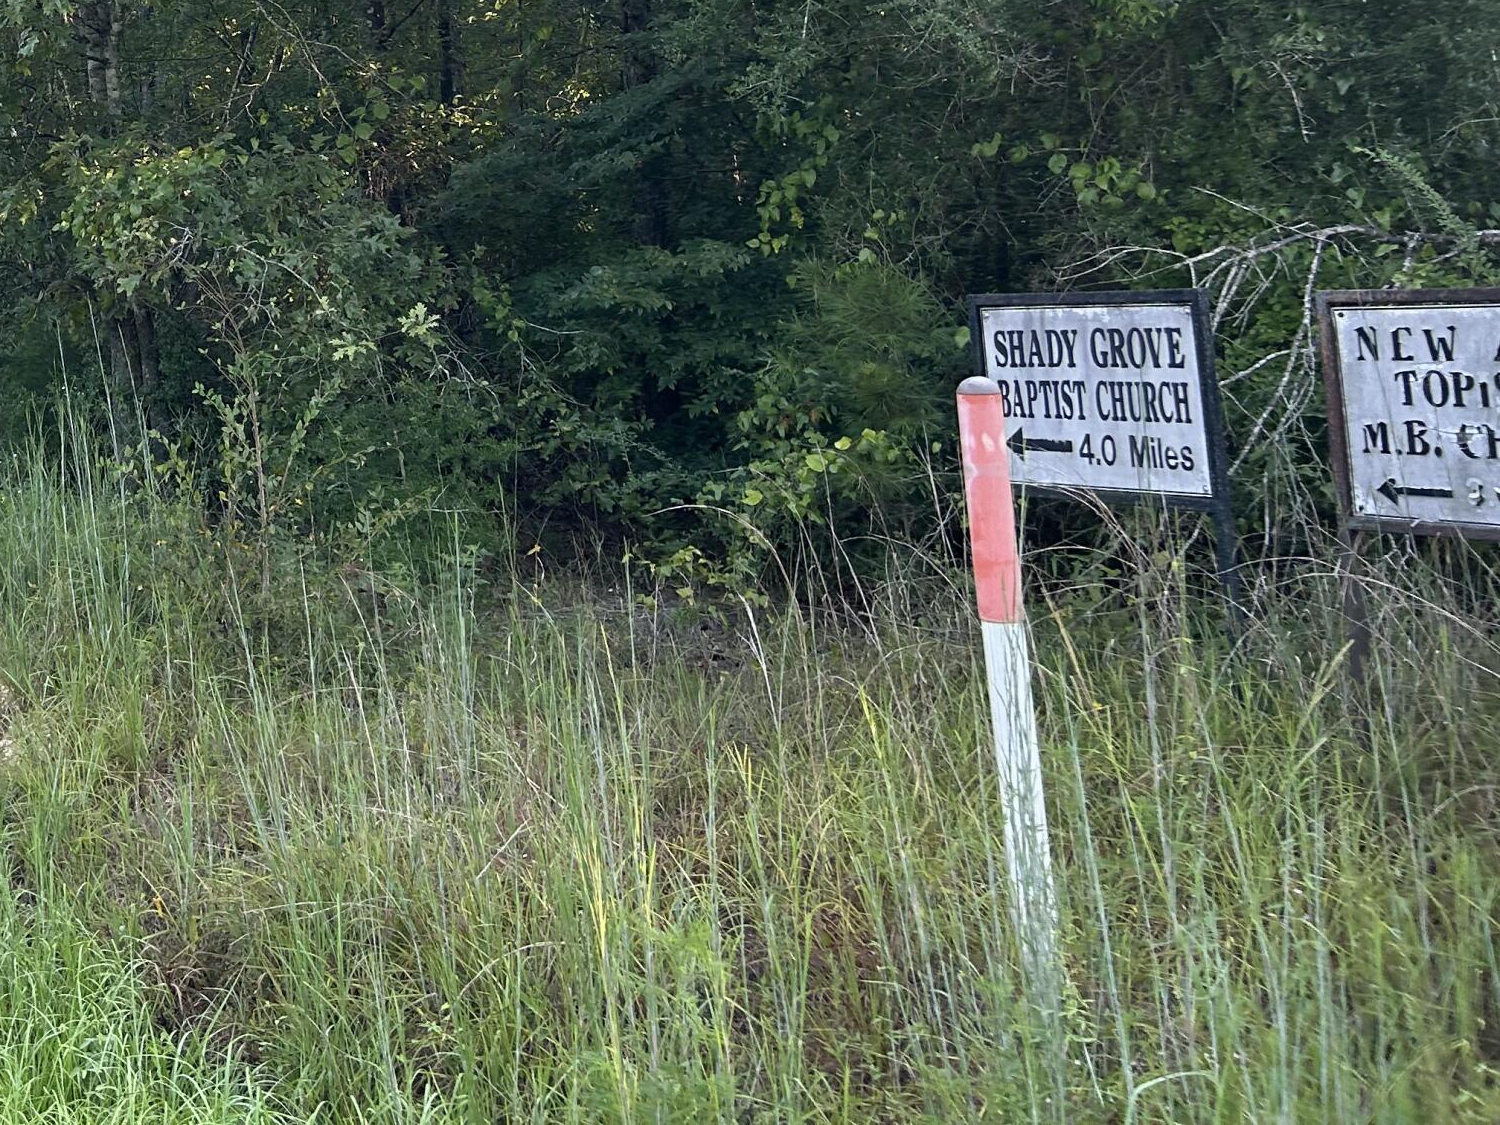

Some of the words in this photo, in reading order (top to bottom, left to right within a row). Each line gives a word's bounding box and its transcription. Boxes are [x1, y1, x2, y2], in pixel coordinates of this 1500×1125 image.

[994, 329, 1078, 369] SHADY
[1090, 327, 1186, 369] GROVE
[1354, 325, 1456, 362] NEW
[998, 379, 1087, 421] BAPTIST
[1095, 380, 1193, 424] CHURCH
[1079, 433, 1117, 467] 4.0
[1129, 434, 1194, 472] Miles
